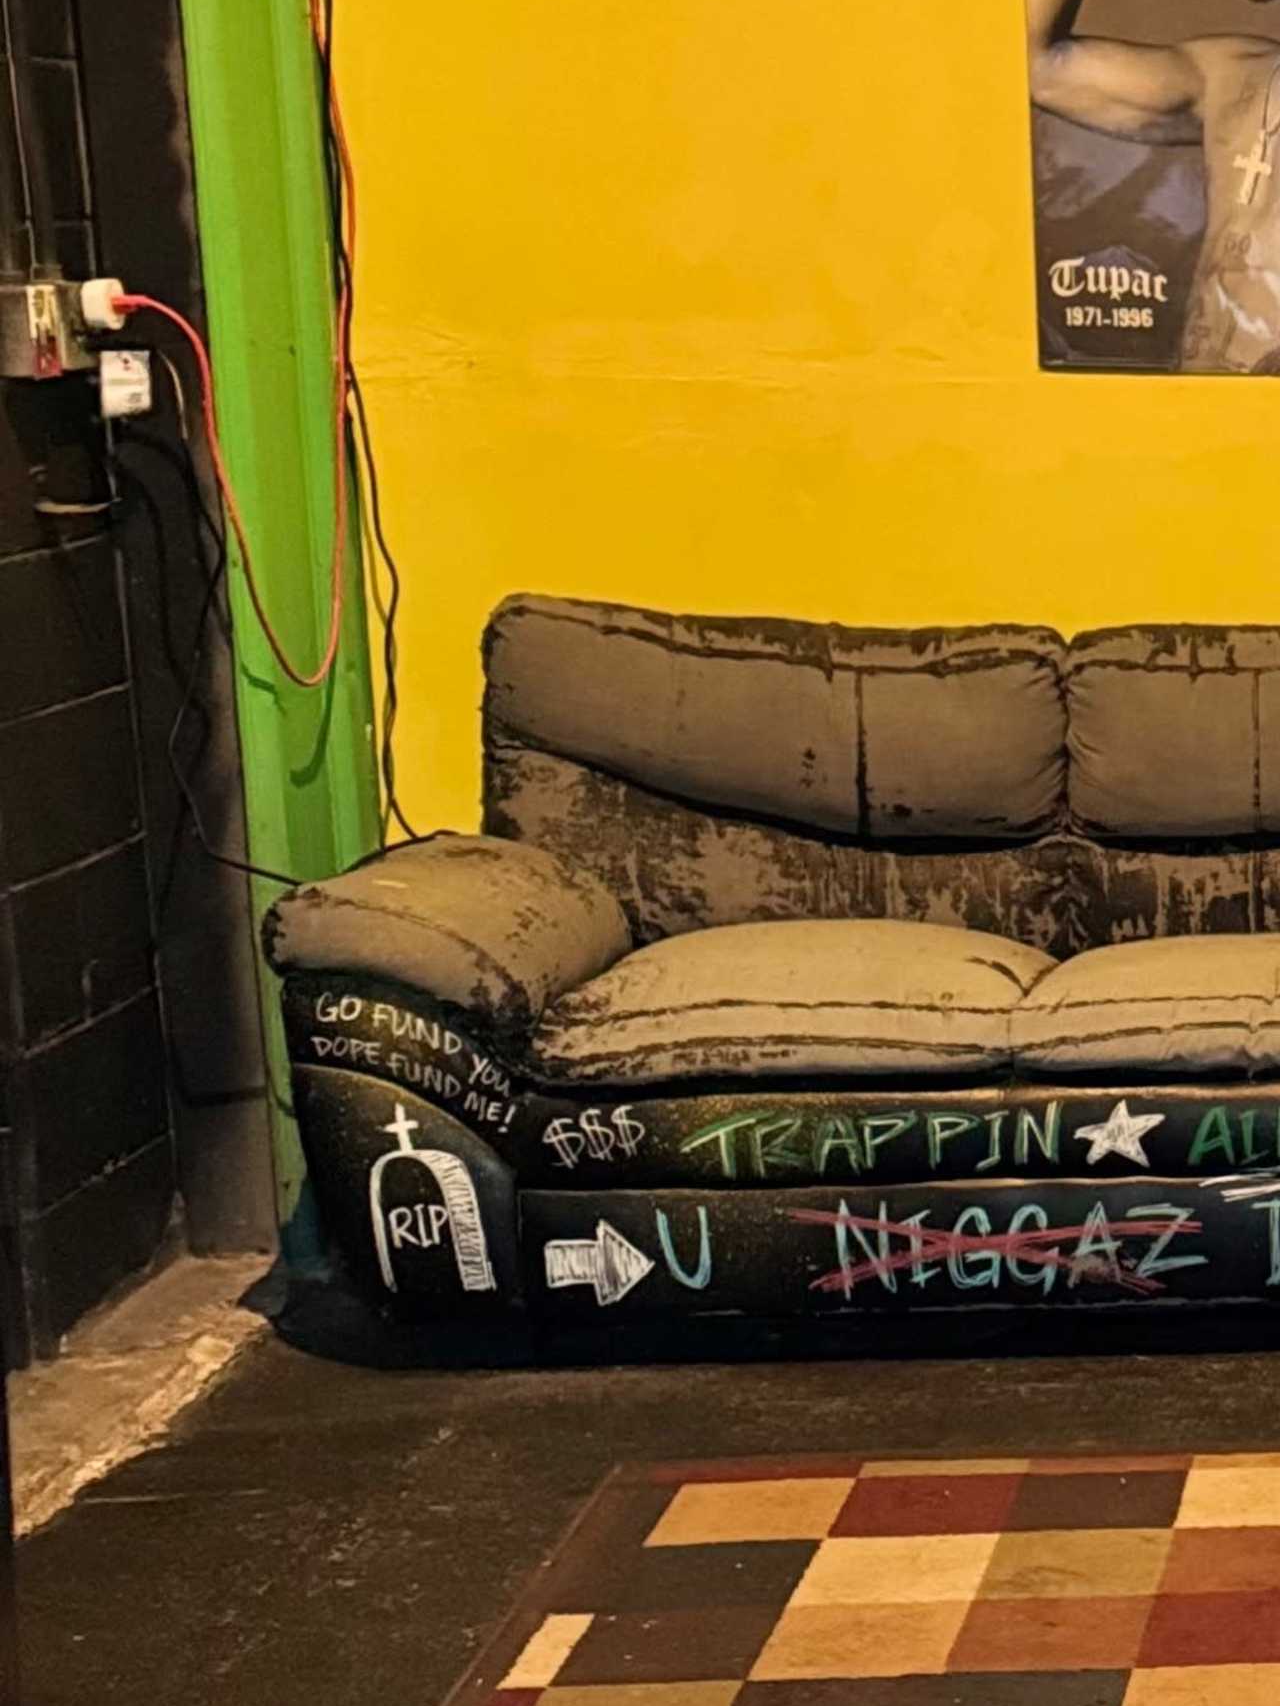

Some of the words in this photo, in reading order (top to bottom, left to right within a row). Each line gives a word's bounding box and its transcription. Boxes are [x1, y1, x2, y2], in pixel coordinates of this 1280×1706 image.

[1047, 256, 1169, 303] Tupac
[1064, 305, 1154, 328] 1971-1996
[310, 1035, 384, 1067] DOPE
[386, 1050, 462, 1099] FUND
[463, 1091, 517, 1134] ME!
[315, 991, 363, 1023] GO
[371, 1002, 463, 1056] FUND
[468, 1053, 511, 1098] YOU
[680, 1097, 1065, 1179] TRAPPIN
[387, 1203, 450, 1249] RIP
[656, 1204, 712, 1290] U
[833, 1197, 1209, 1301] NIGGAZ
